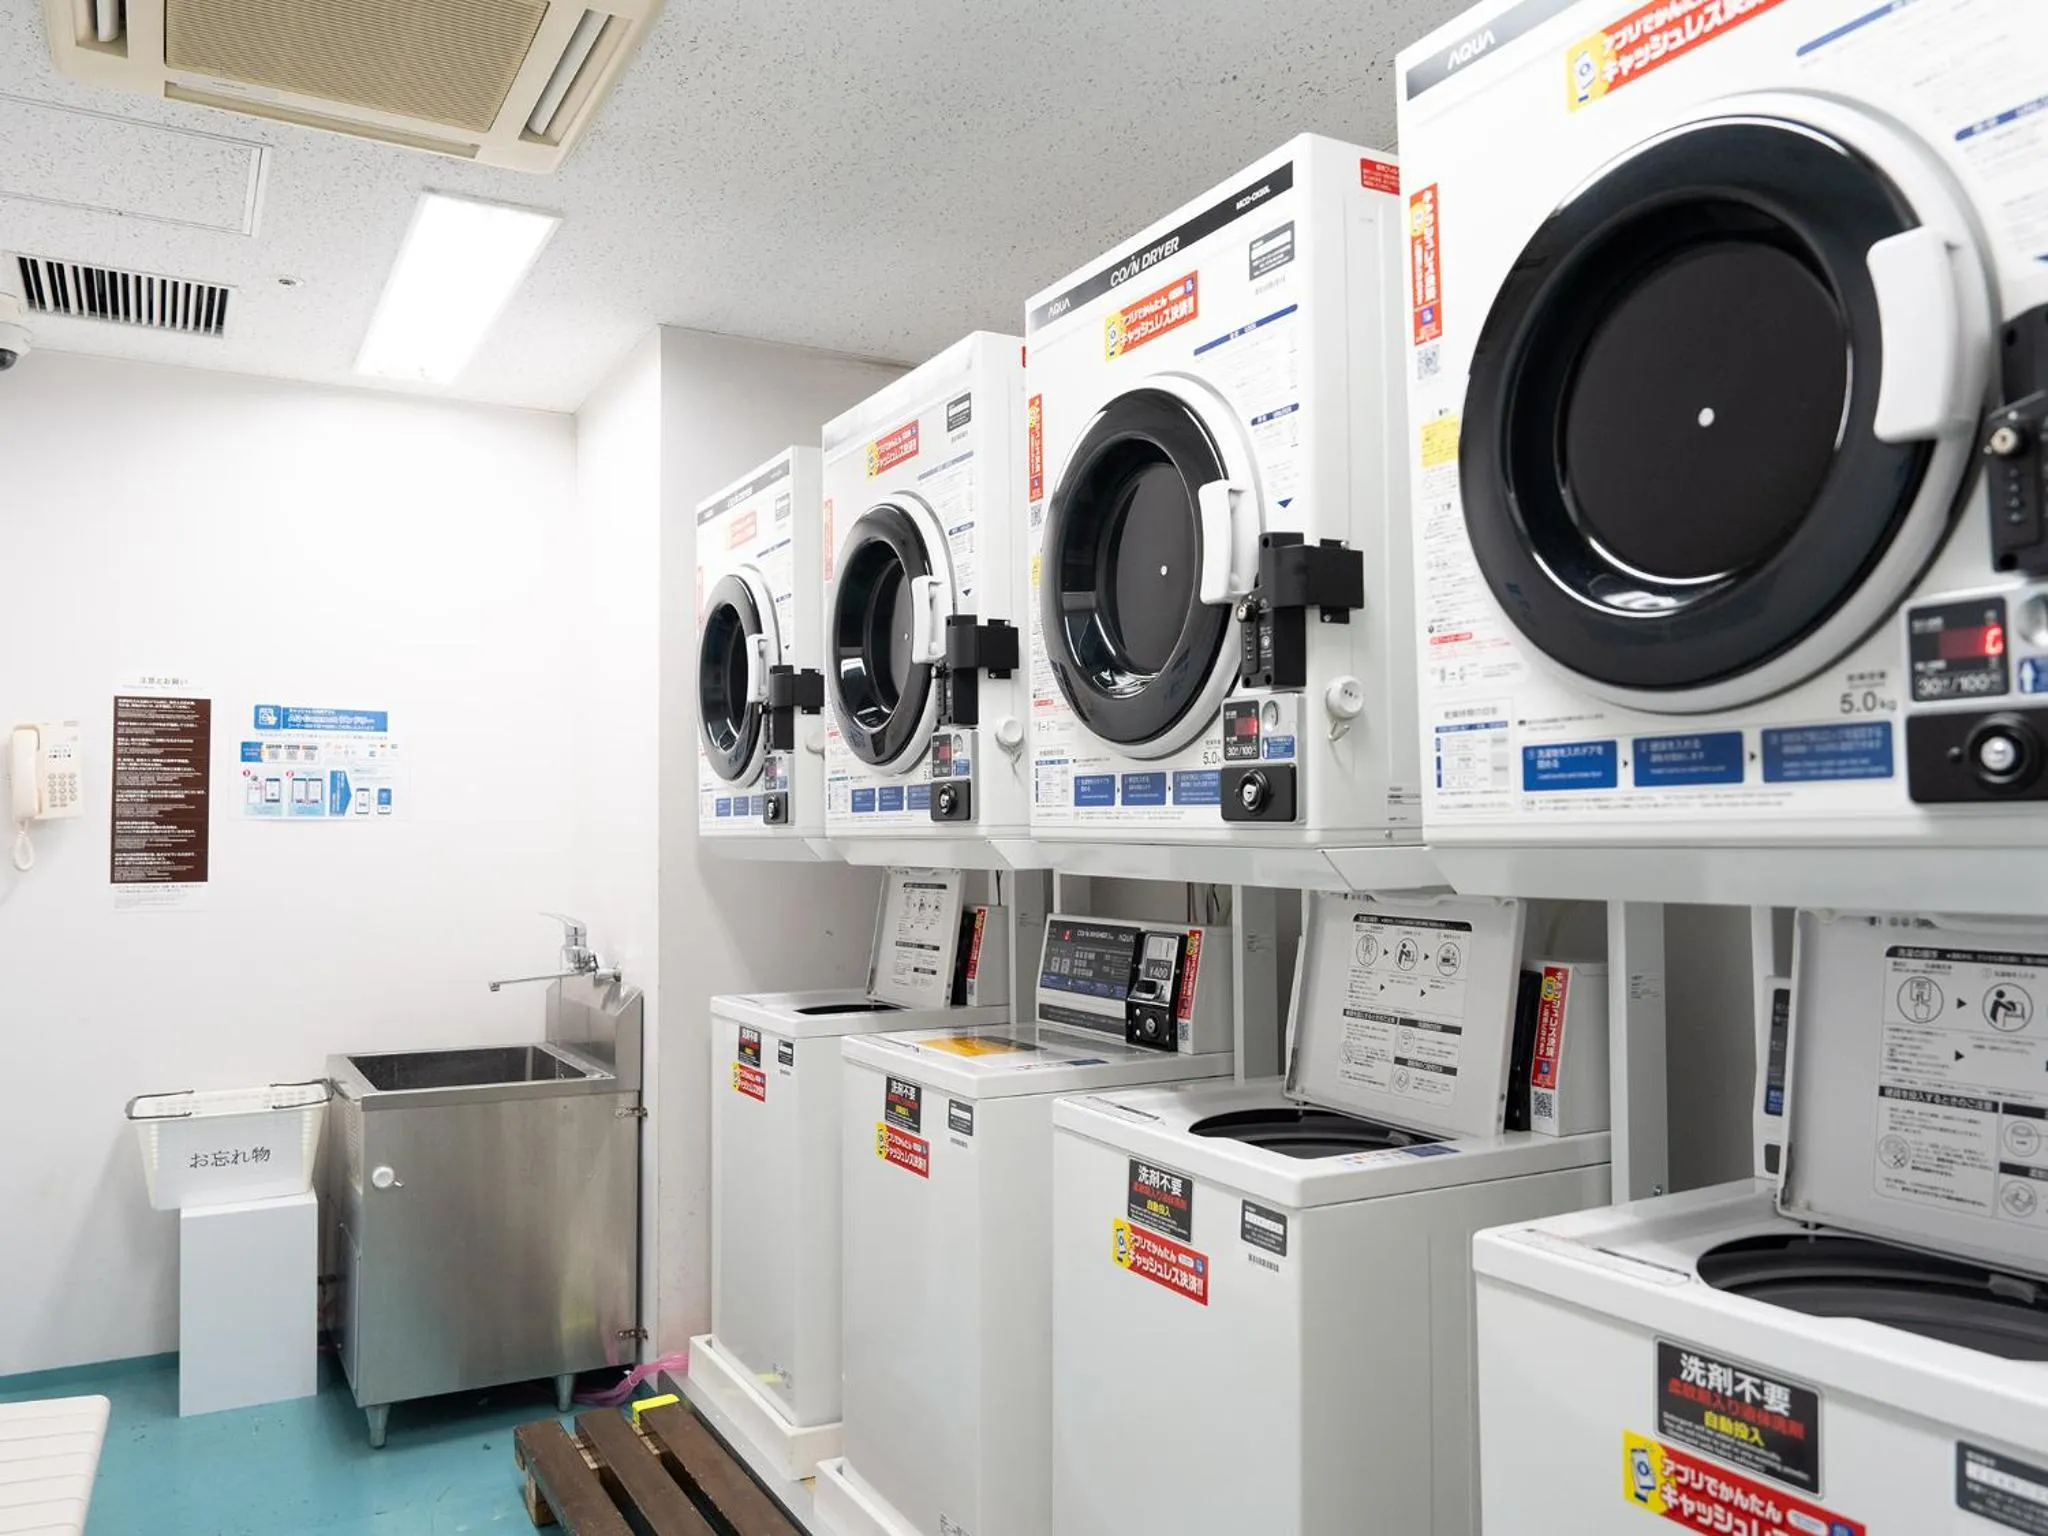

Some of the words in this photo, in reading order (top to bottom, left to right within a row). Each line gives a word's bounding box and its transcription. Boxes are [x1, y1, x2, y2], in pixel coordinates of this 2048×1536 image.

[1447, 29, 1496, 71] AQUA
[1110, 254, 1140, 287] COIN
[1142, 236, 1180, 268] DRYER
[1048, 298, 1071, 319] AQUA
[1841, 691, 1898, 715] 5.0kg
[190, 1146, 271, 1168] お忘れ物
[1137, 1165, 1183, 1197] 洗剤不要
[1680, 1352, 1792, 1417] 洗剤不要
[1704, 1410, 1765, 1448] 自動投入
[1660, 1458, 1783, 1524] アプリでかんたん
